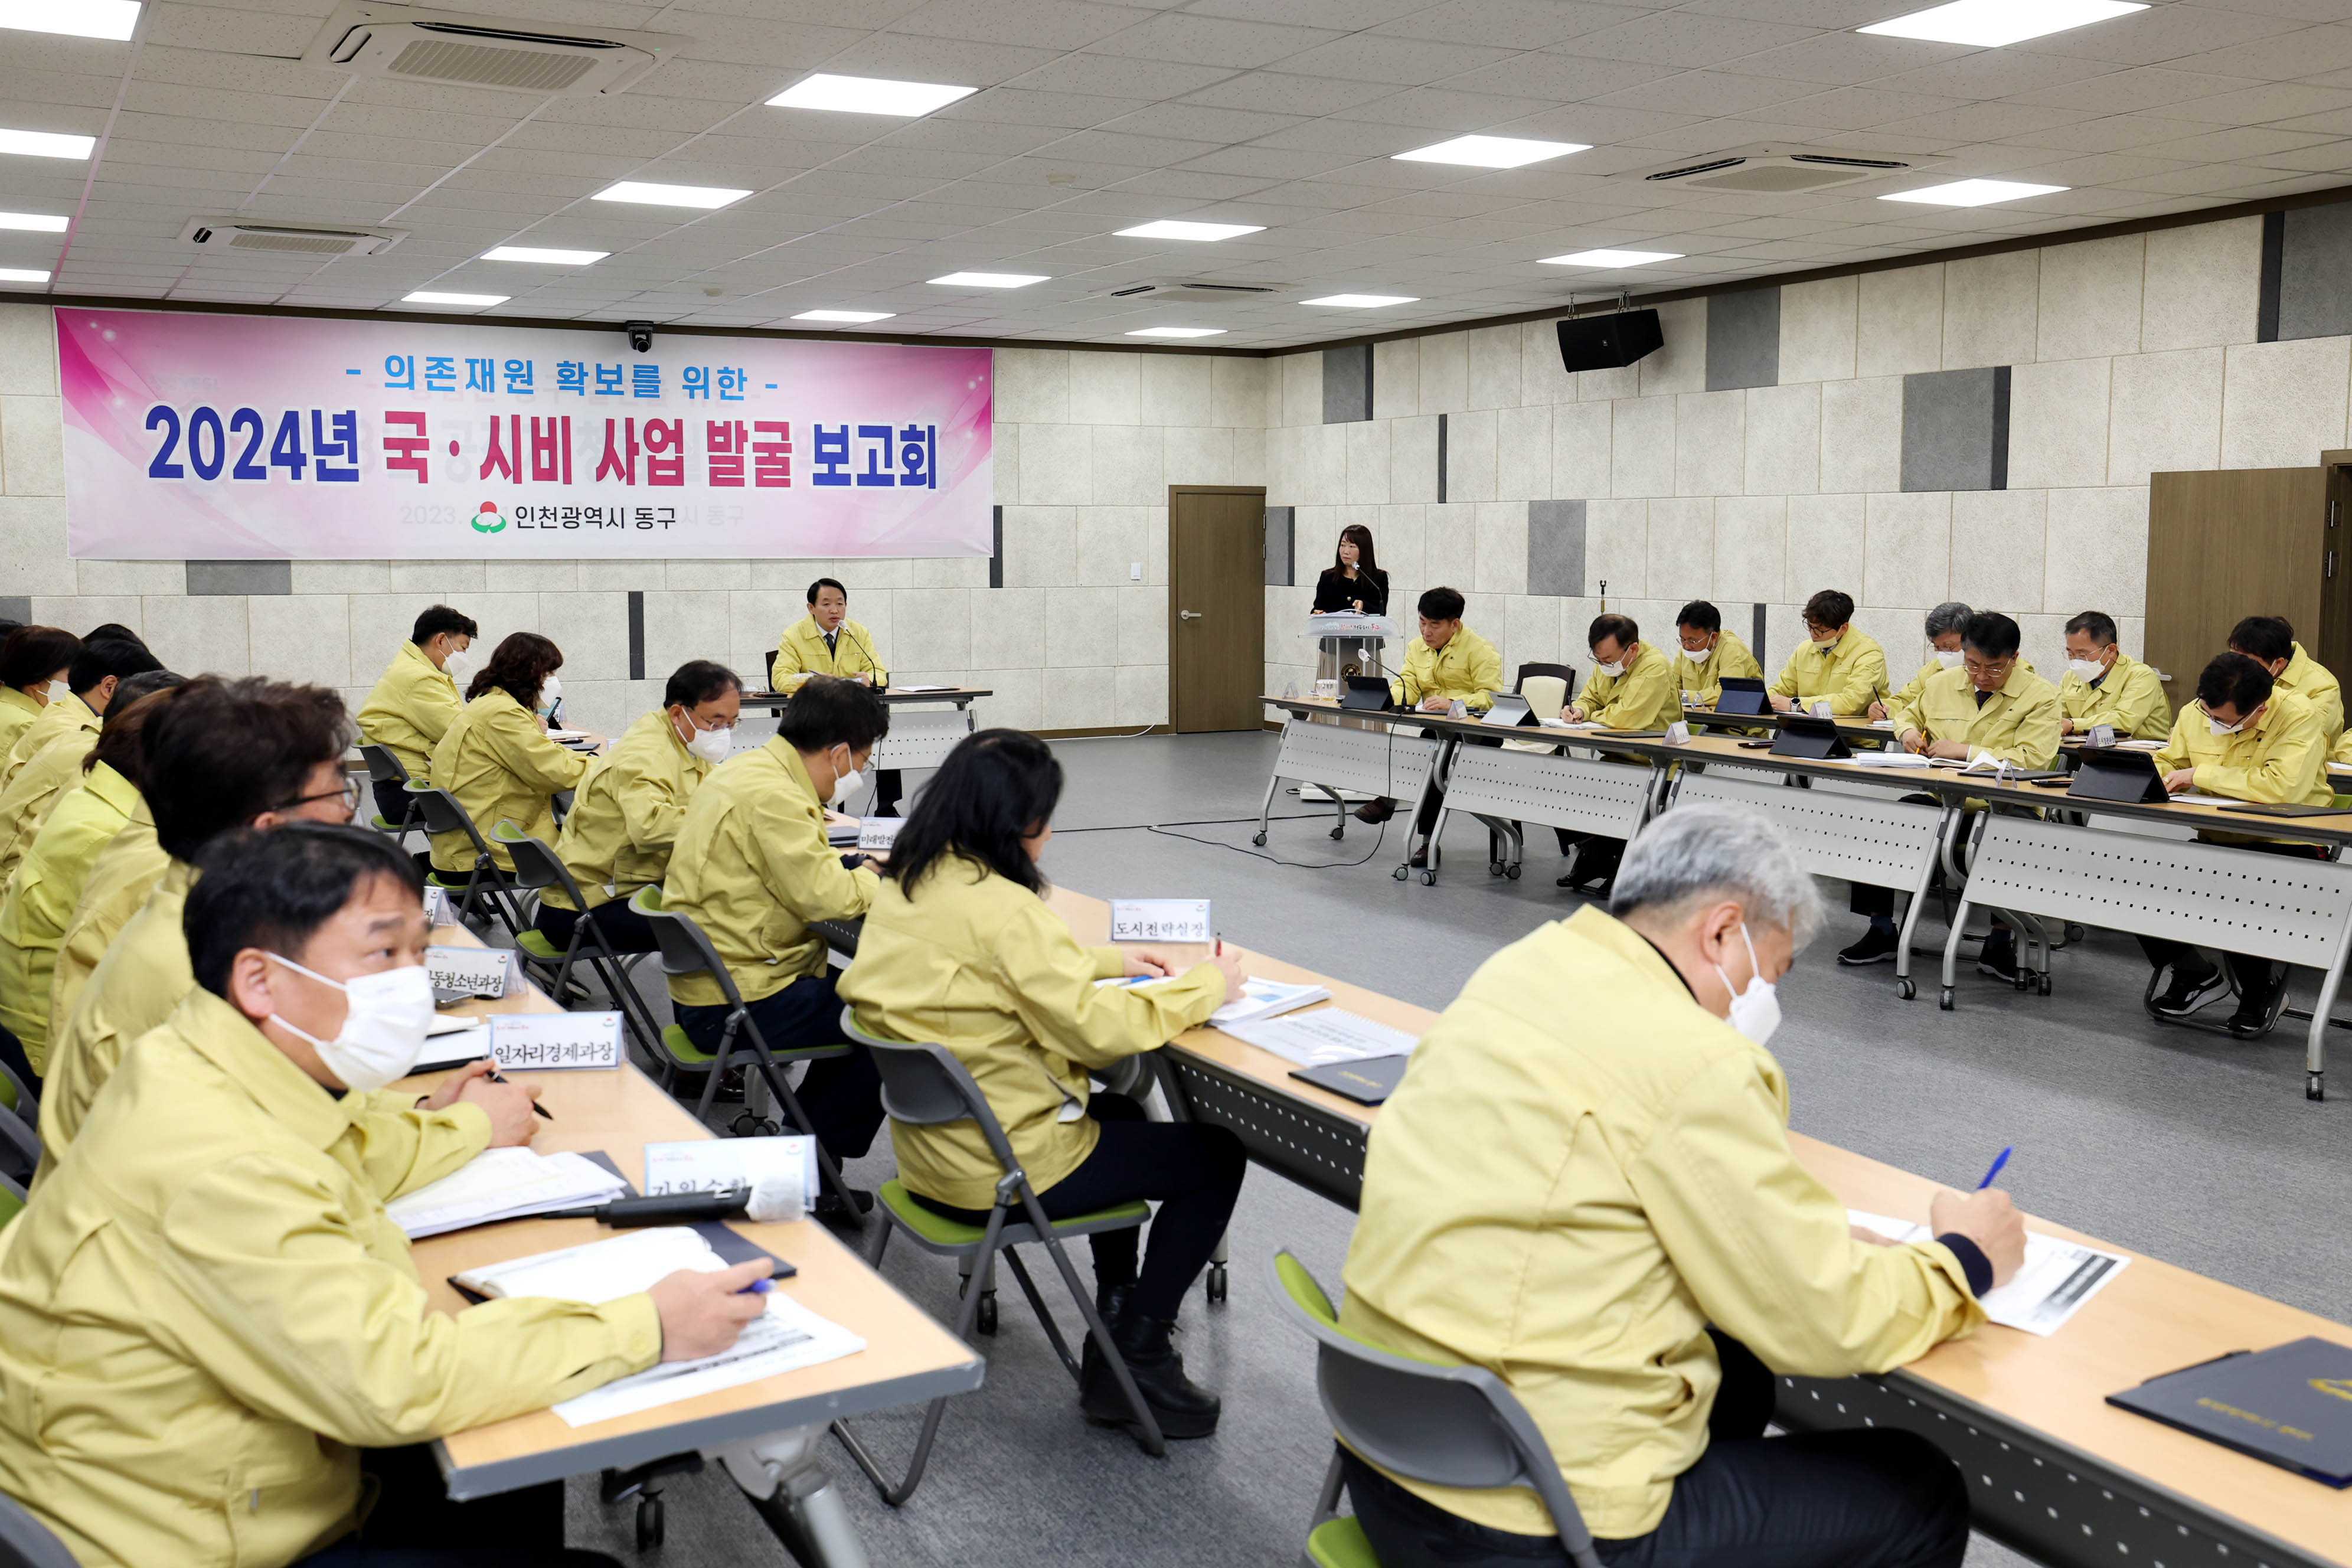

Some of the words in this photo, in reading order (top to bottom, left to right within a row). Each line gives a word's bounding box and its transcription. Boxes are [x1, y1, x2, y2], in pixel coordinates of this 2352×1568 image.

[384, 355, 534, 395] 의존재원
[557, 360, 661, 398] 확보를
[682, 367, 748, 401] 위한
[145, 405, 360, 482] 2024년
[596, 417, 684, 486] 사업
[707, 420, 792, 488] 발굴
[812, 424, 936, 489] 보고회
[515, 506, 625, 530] 인천광역시
[635, 508, 676, 530] 동구
[861, 834, 895, 845] 미래발전
[1115, 921, 1204, 937] 도시전략실장
[495, 1041, 614, 1064] 일자리경제과장
